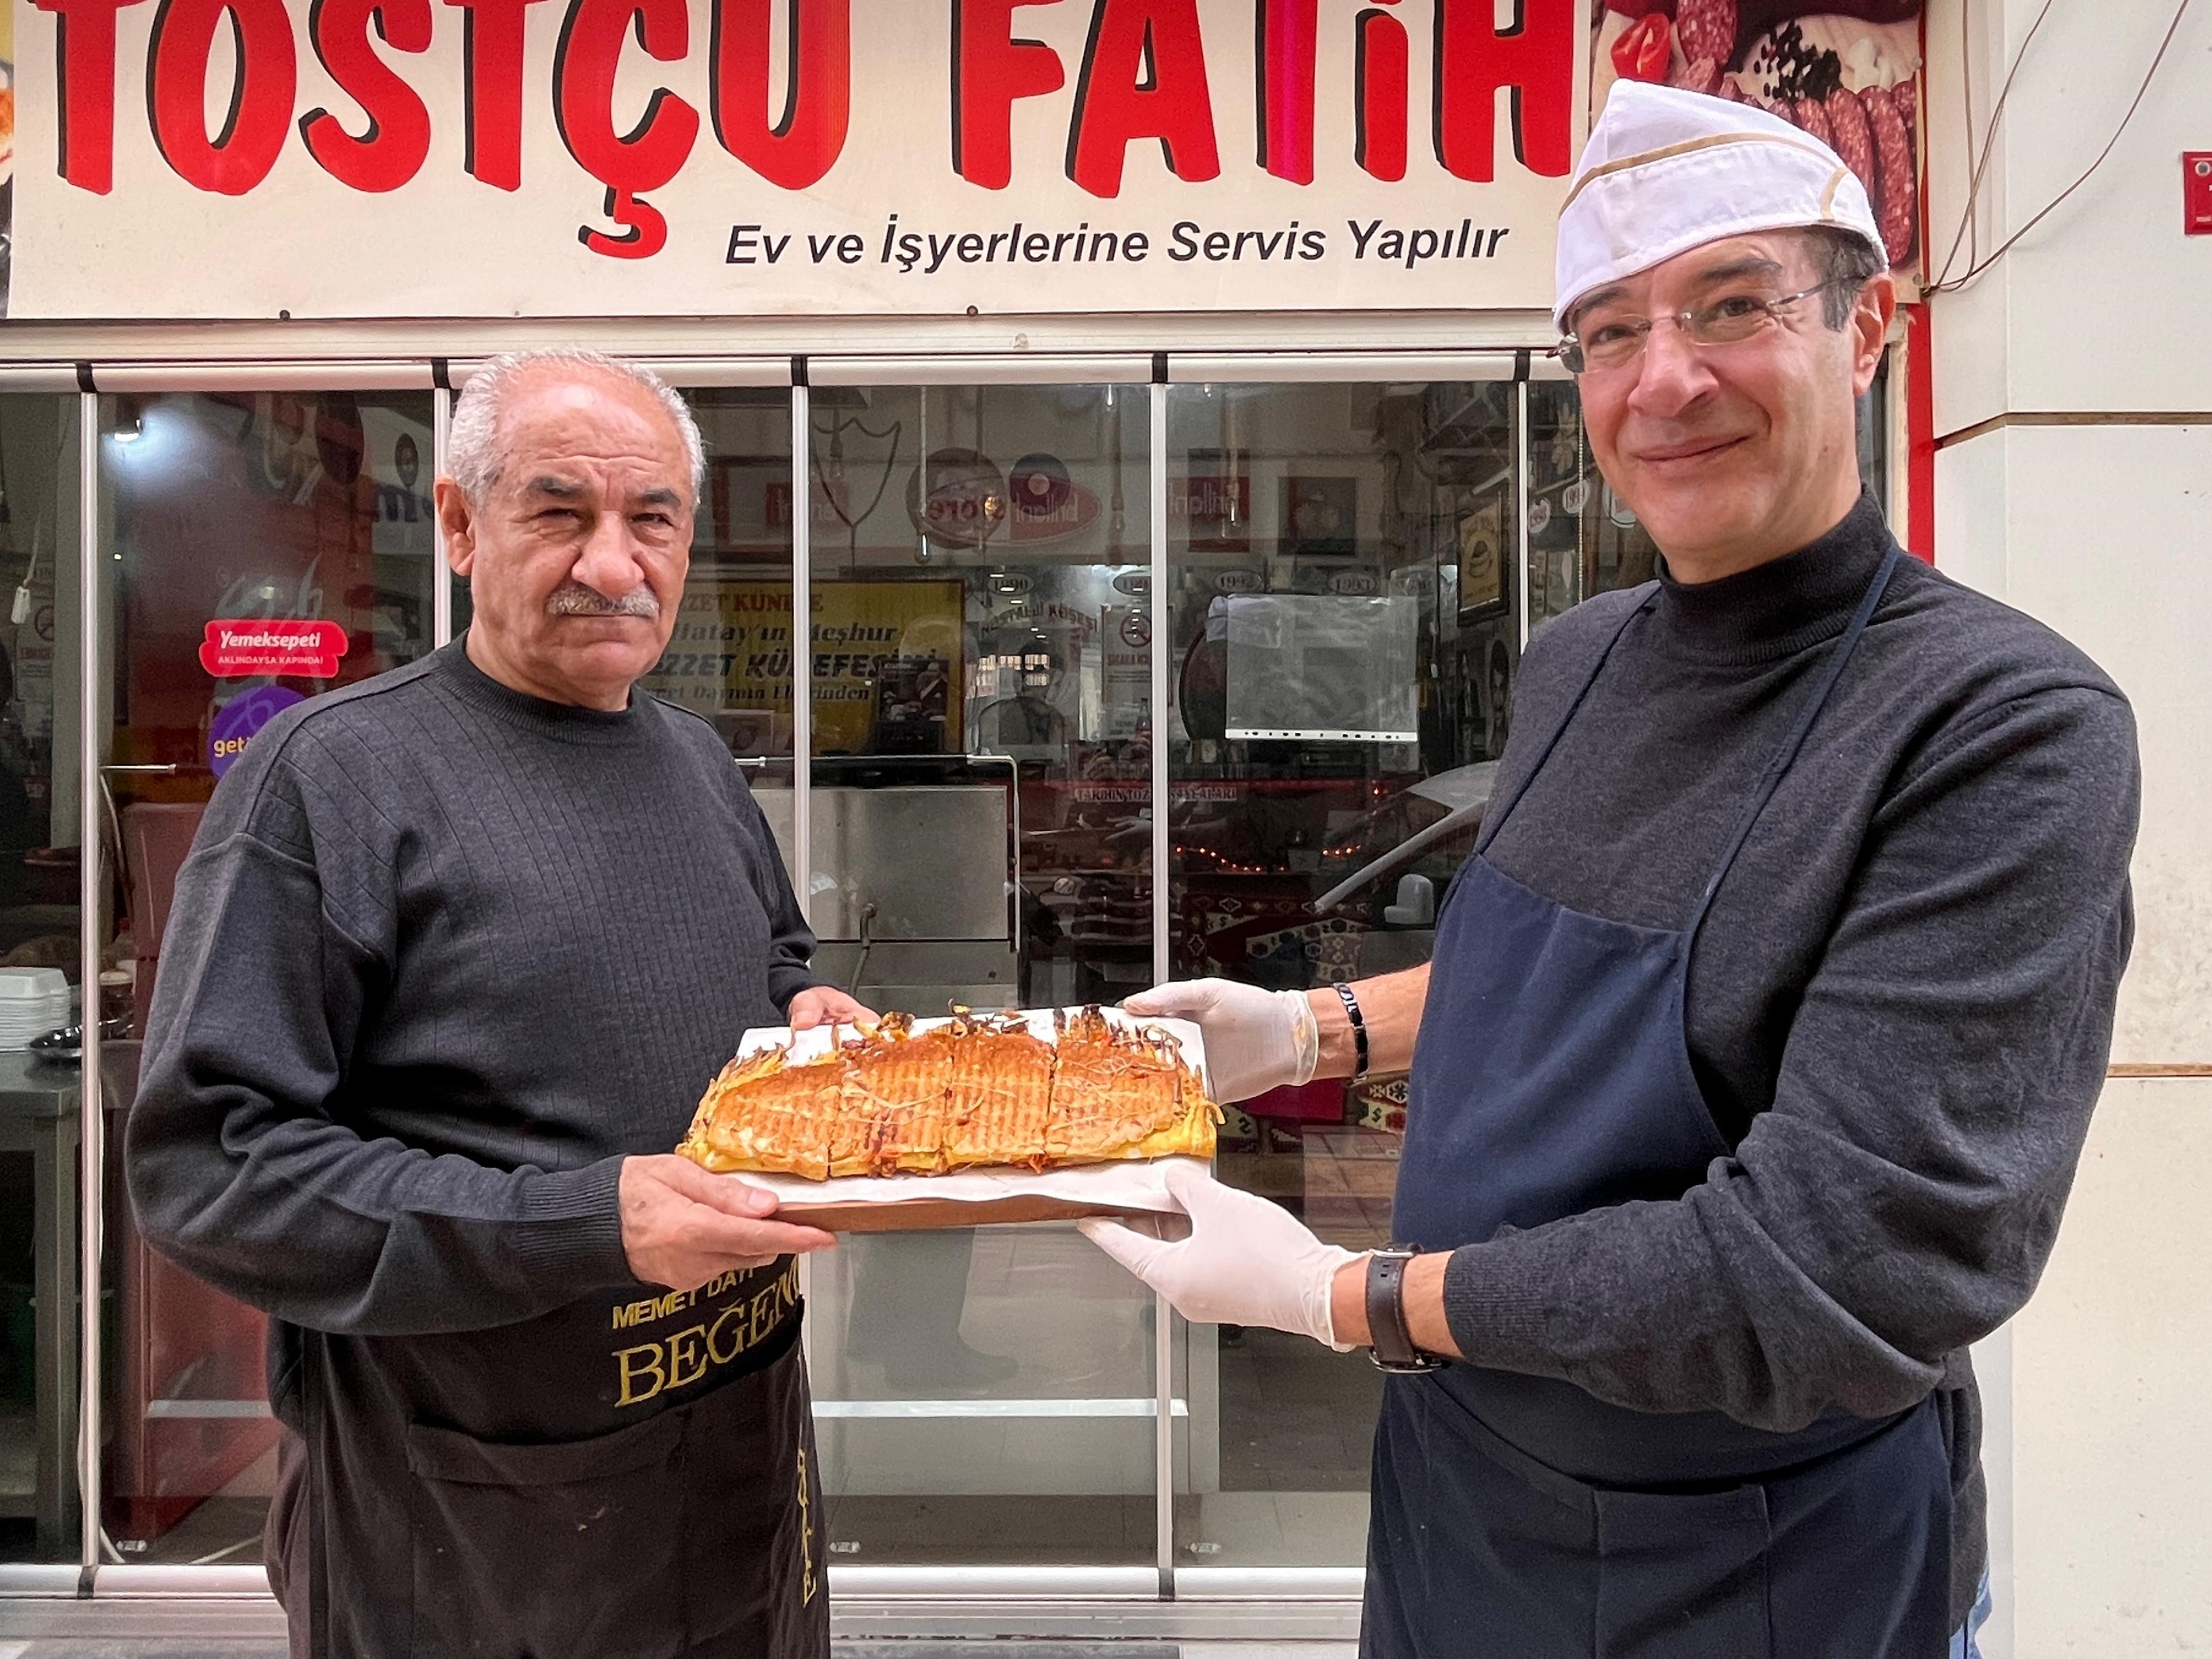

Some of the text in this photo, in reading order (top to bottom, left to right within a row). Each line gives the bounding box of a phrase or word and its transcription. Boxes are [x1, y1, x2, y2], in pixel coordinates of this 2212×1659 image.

[726, 214, 1510, 273] Ev ve İşyerlerine Servis Yapılır
[220, 630, 321, 651] Yemeksepeti
[218, 656, 277, 664] AKLINDAYSA
[213, 737, 252, 758] get
